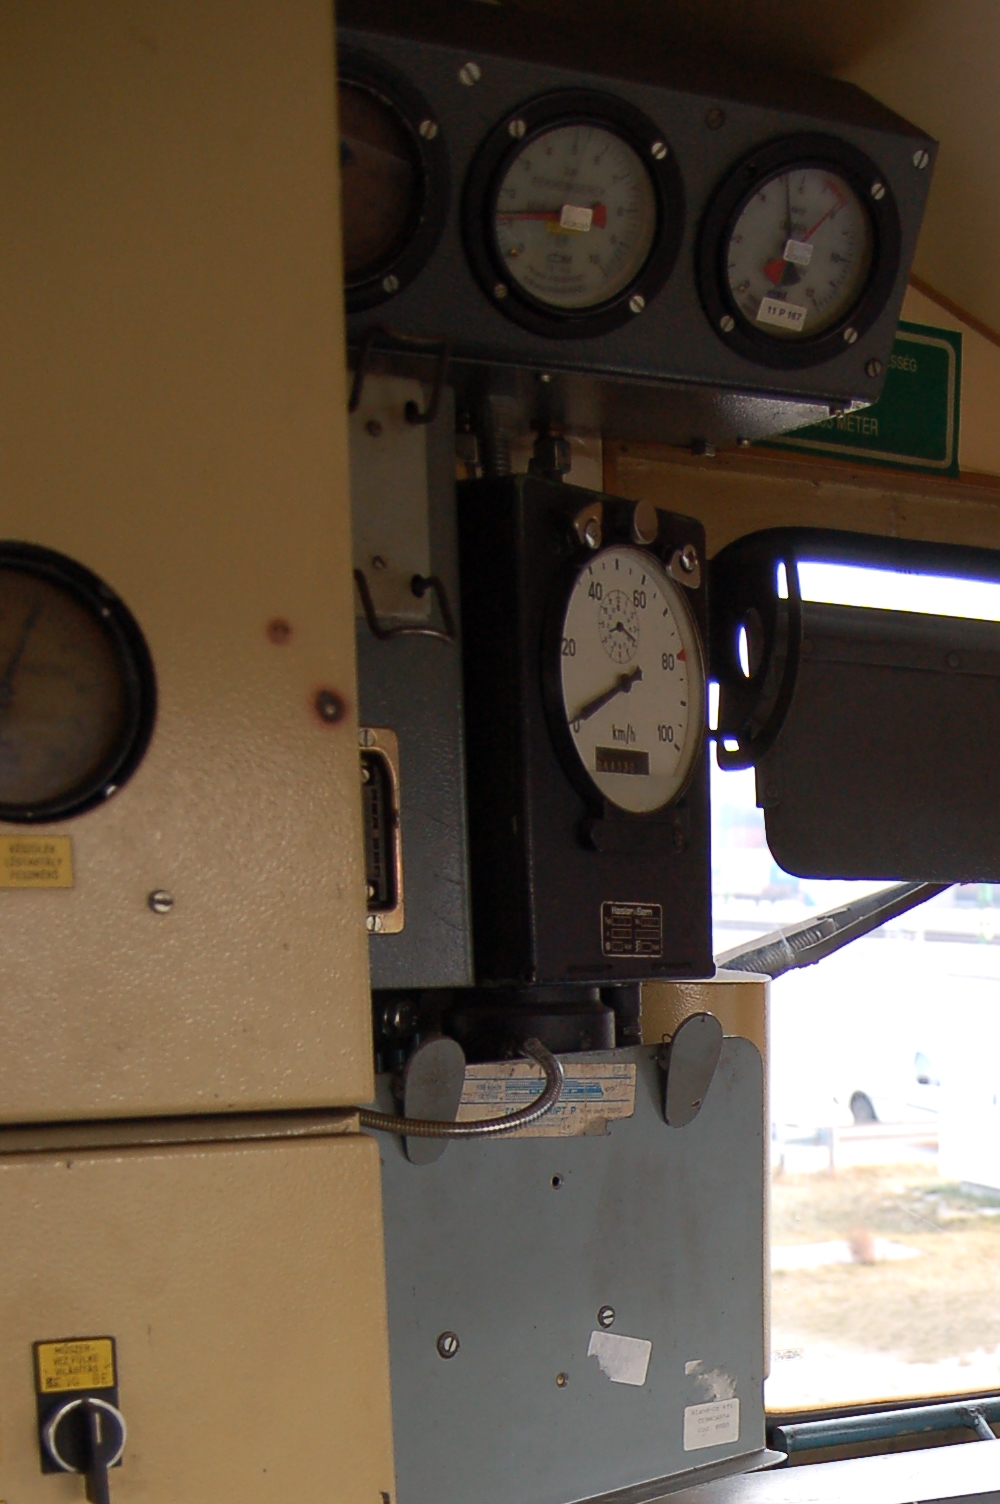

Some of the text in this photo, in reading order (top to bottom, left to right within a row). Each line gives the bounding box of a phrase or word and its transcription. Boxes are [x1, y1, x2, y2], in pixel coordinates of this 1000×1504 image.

[588, 582, 602, 601] 40
[633, 590, 647, 609] 60
[561, 638, 576, 657] 20
[661, 653, 675, 671] 80
[612, 724, 637, 744] km/h
[657, 725, 673, 742] 100
